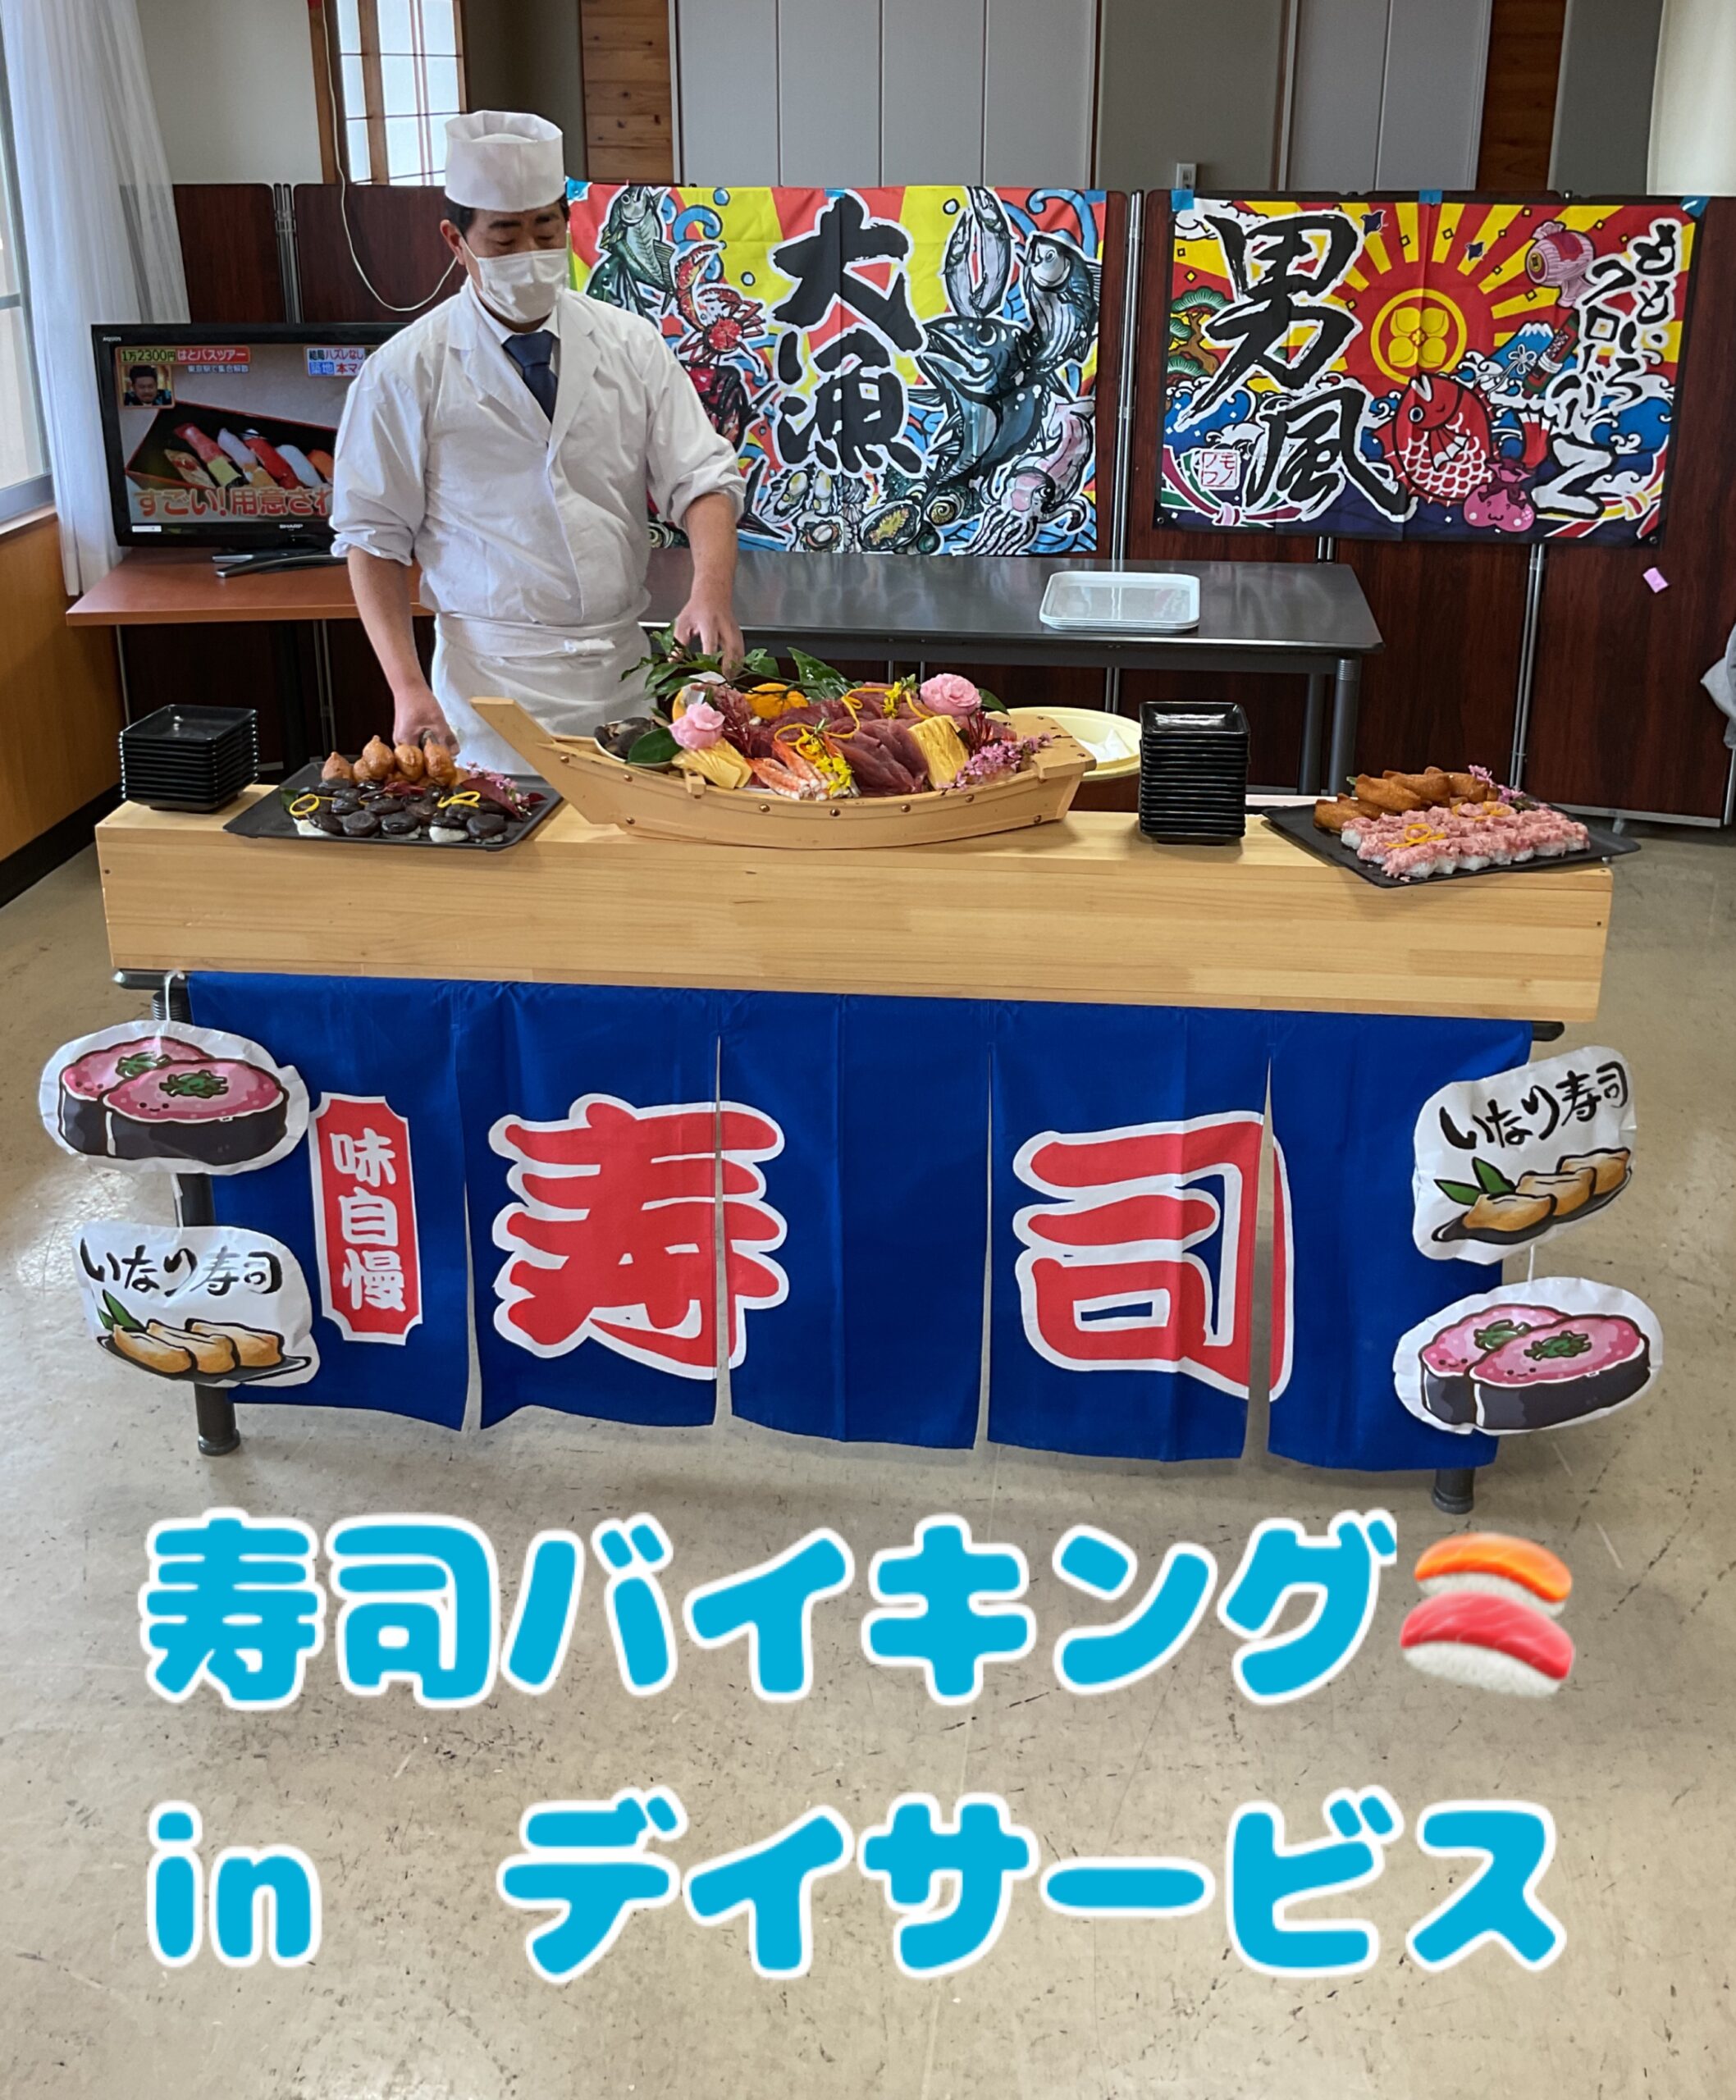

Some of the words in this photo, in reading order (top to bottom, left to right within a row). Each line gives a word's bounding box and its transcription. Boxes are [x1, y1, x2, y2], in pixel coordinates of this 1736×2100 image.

[122, 349, 176, 362] 1万2300円
[177, 349, 246, 361] はとバスツアー
[336, 363, 363, 374] 本マ
[773, 190, 926, 477] 大漁
[1175, 210, 1418, 521] 男風
[1439, 1061, 1629, 1149] いなり寿司
[80, 1237, 284, 1298] いなり寿司
[330, 1128, 406, 1312] 味自慢
[489, 1093, 1294, 1401] 寿司
